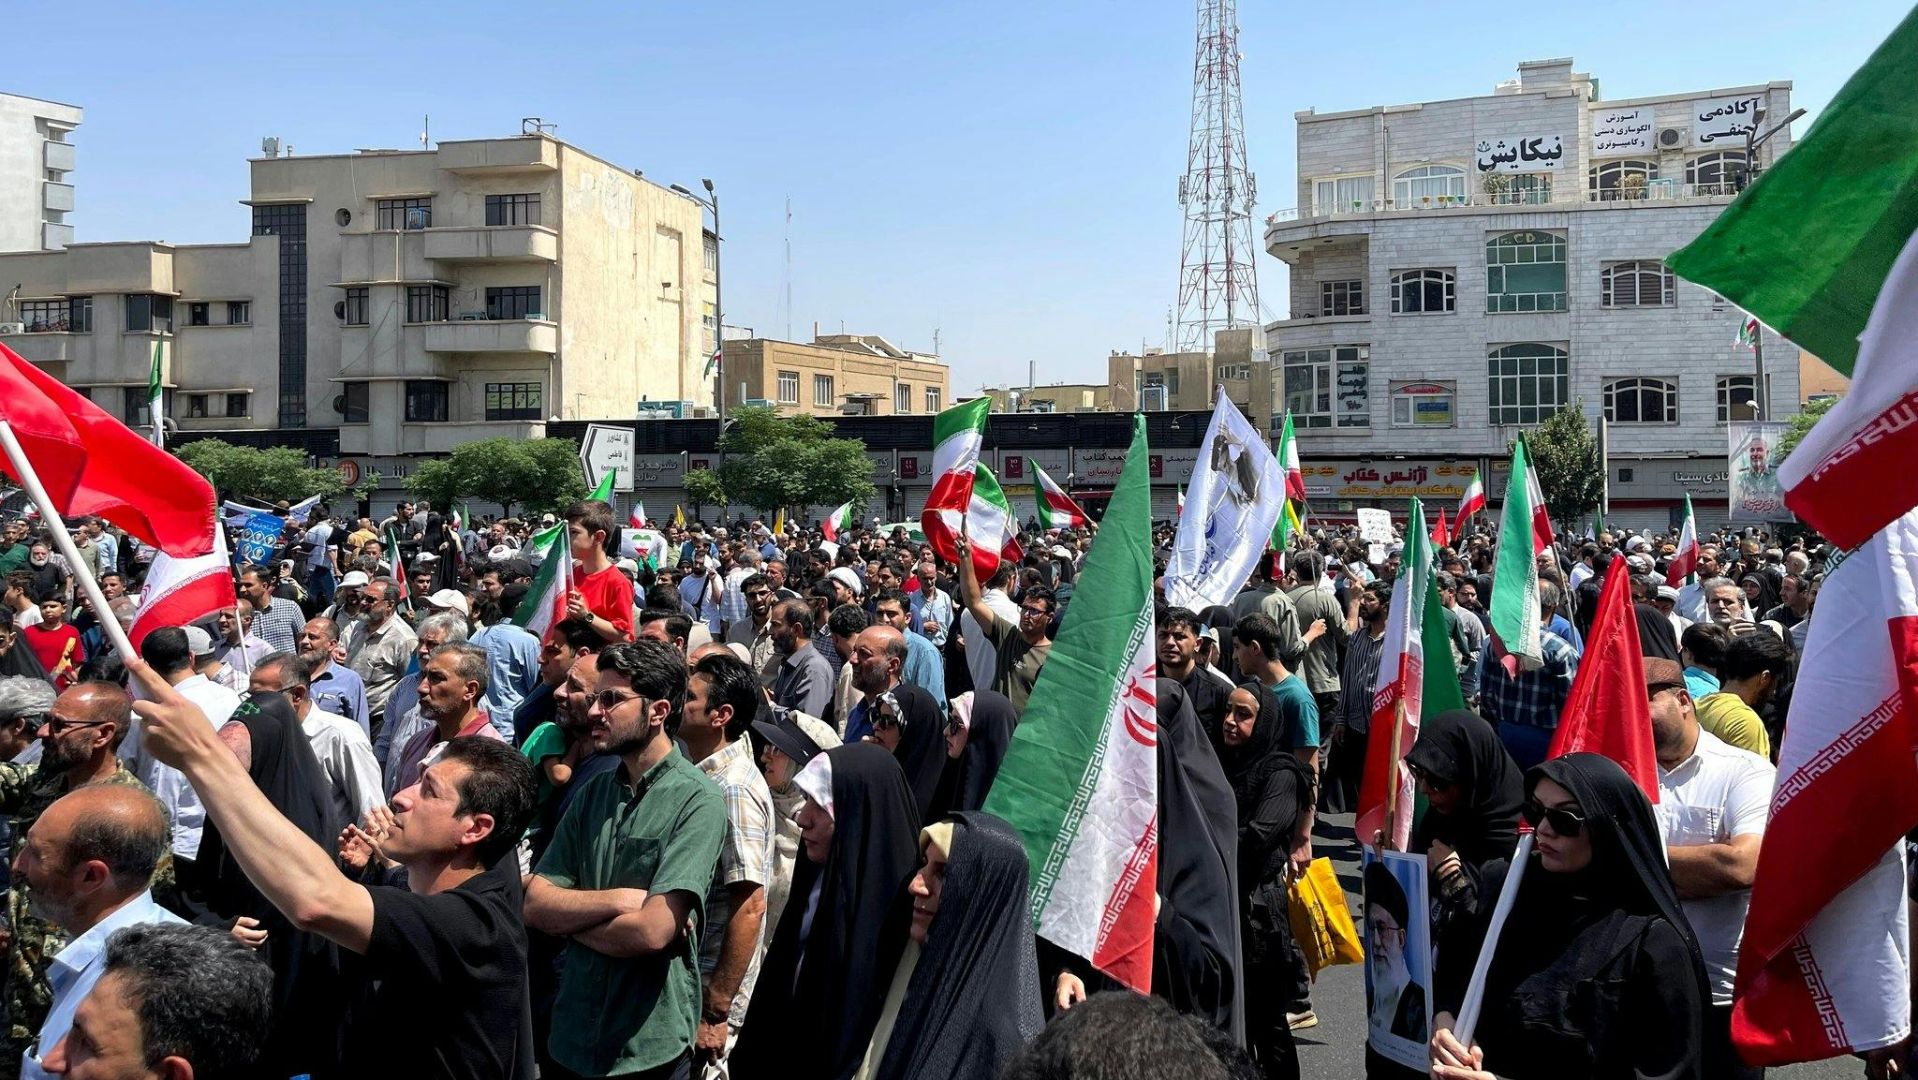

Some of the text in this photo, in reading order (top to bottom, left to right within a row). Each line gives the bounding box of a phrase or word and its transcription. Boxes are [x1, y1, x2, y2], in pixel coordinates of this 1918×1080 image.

[1699, 96, 1761, 122] آکادمی
[1605, 111, 1639, 123] آموزش
[1594, 127, 1615, 137] دستی
[1477, 136, 1563, 171] نیکایش
[608, 450, 622, 460] فاطمی
[1343, 467, 1380, 484] کتاب
[1383, 465, 1428, 485] آژانس
[1674, 471, 1729, 485] نادی سینا
